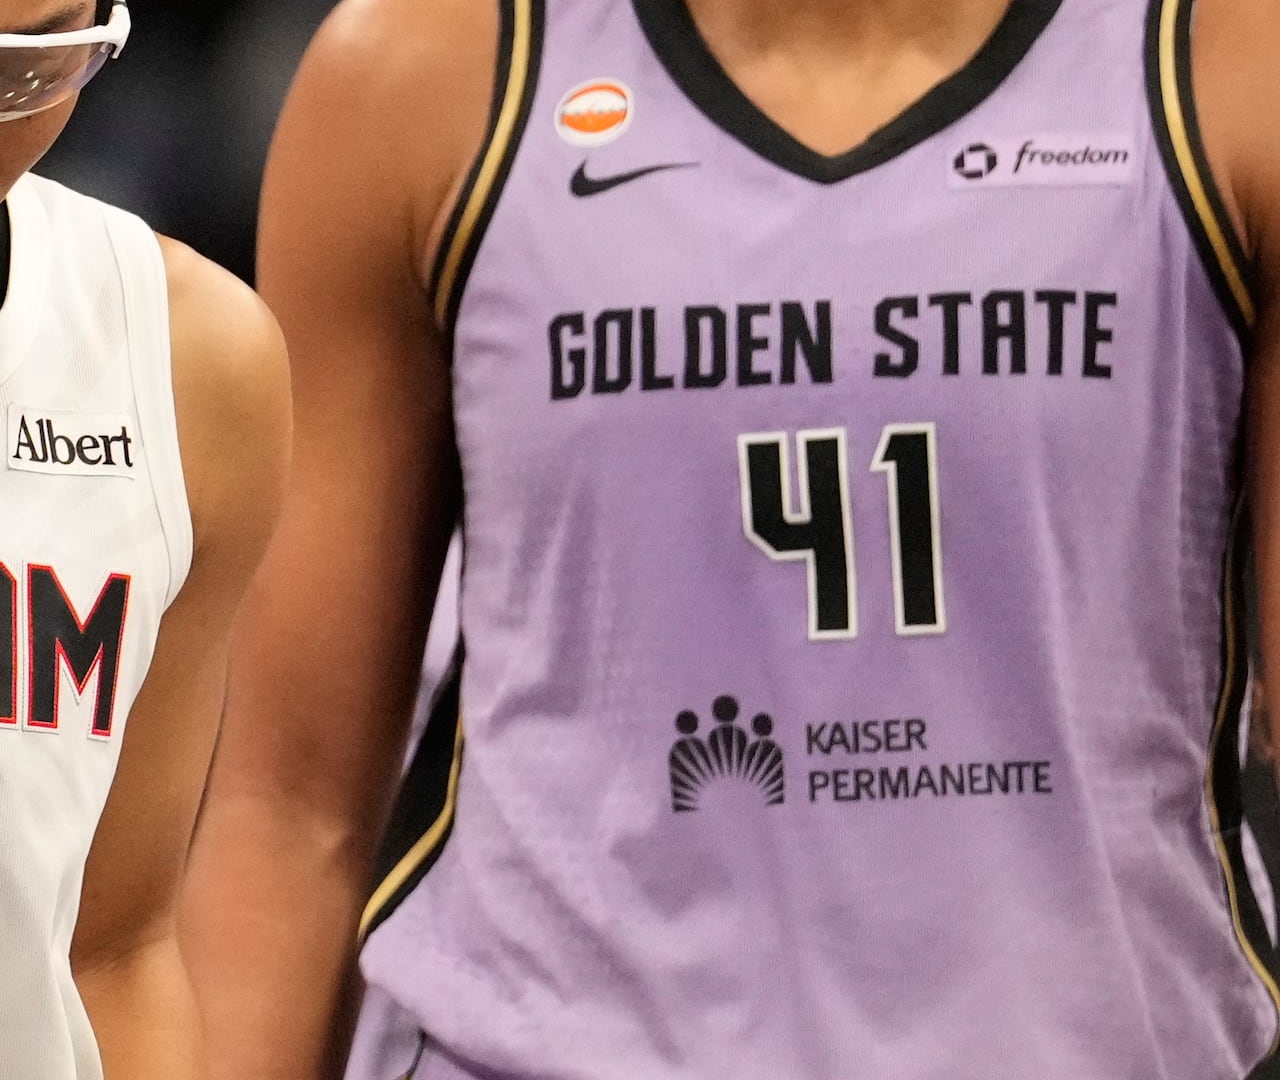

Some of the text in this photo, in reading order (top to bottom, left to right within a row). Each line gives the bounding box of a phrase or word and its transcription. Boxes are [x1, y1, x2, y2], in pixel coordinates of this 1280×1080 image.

[1013, 139, 1129, 174] freedom
[548, 289, 1119, 402] GOLDEN STATE
[12, 414, 134, 468] Albert
[741, 425, 944, 640] 41
[806, 718, 928, 756] KAISER
[808, 760, 1053, 803] PERMANENTE
